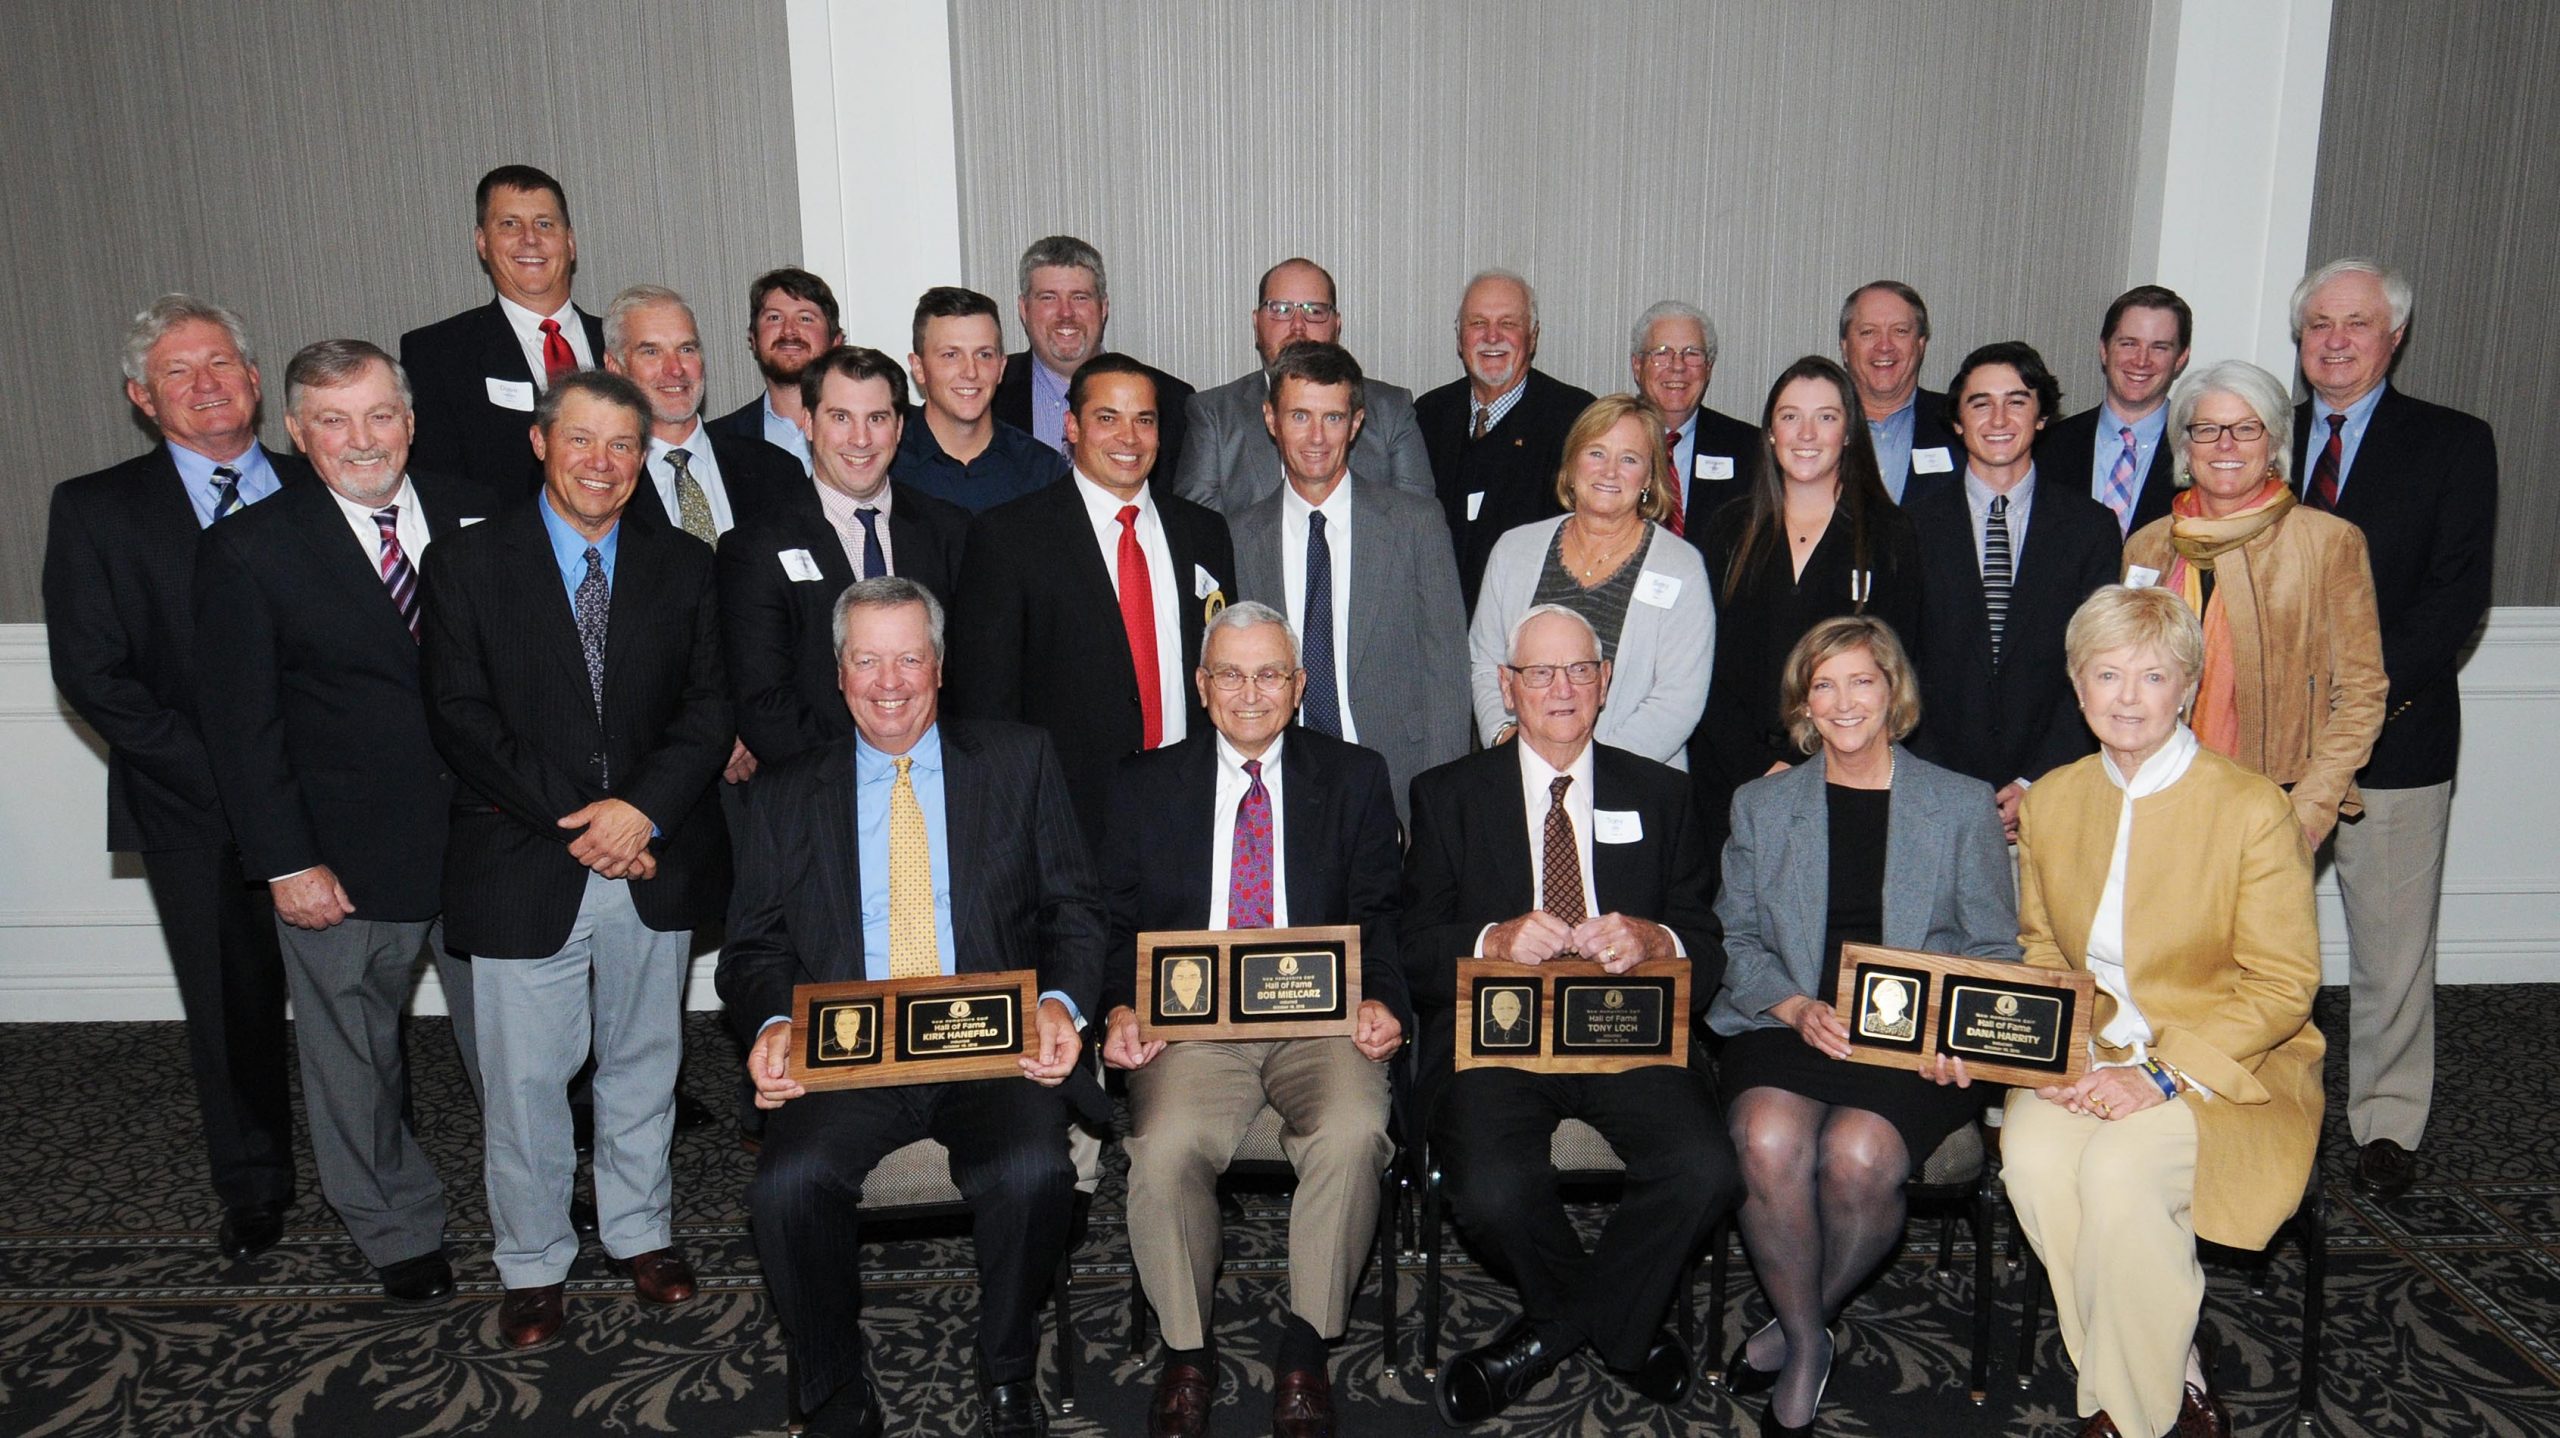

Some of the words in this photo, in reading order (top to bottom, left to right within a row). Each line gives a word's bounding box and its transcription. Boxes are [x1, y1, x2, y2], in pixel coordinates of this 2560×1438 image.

[1281, 981, 1289, 989] of
[1257, 991, 1276, 999] BOB
[1278, 989, 1321, 999] MIELCARZ
[1588, 1024, 1612, 1032] TONY
[1614, 1024, 1638, 1032] LOCH
[1978, 1019, 1994, 1028] Hall
[2007, 1023, 2032, 1033] Fame
[923, 1033, 945, 1041] KIRK
[948, 1029, 998, 1039] HANEFELD
[1967, 1027, 1995, 1039] DANA
[1997, 1031, 2040, 1045] HARRITY
